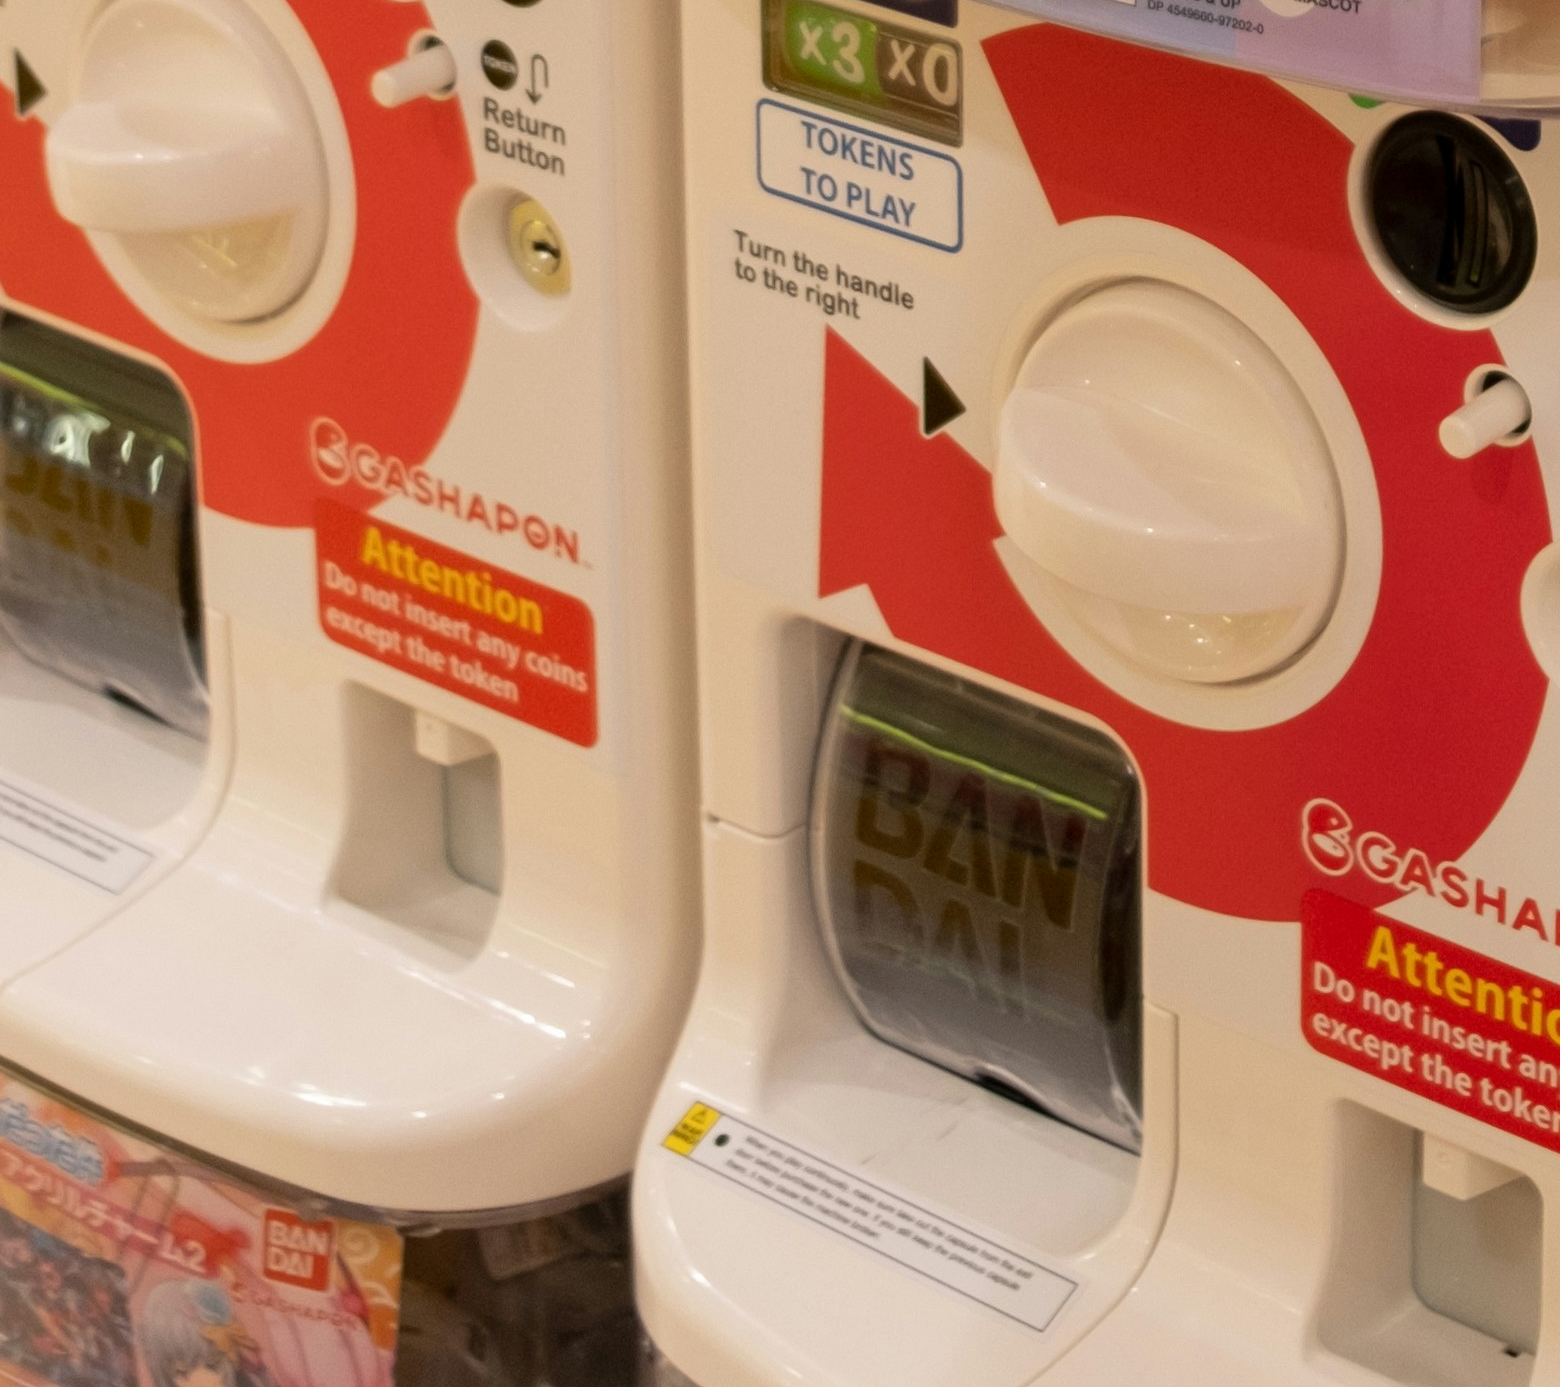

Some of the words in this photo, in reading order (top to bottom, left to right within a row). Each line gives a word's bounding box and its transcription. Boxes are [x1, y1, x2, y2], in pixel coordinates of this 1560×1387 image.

[482, 96, 568, 149] Return
[482, 126, 566, 178] Button
[800, 120, 916, 181] TOKENS
[801, 166, 838, 202] TO
[845, 182, 917, 228] PLAY
[734, 229, 787, 268] Turn
[793, 250, 829, 281] the
[835, 266, 915, 310] handle
[734, 258, 758, 283] to
[762, 268, 800, 299] the
[805, 282, 861, 321] right
[352, 444, 580, 565] GASHAPON
[359, 525, 546, 635] Attention
[1313, 961, 1355, 1004] Do
[1362, 988, 1415, 1031] not
[1421, 1010, 1514, 1071] insert
[1313, 1012, 1414, 1075] except
[1421, 1053, 1472, 1098] the
